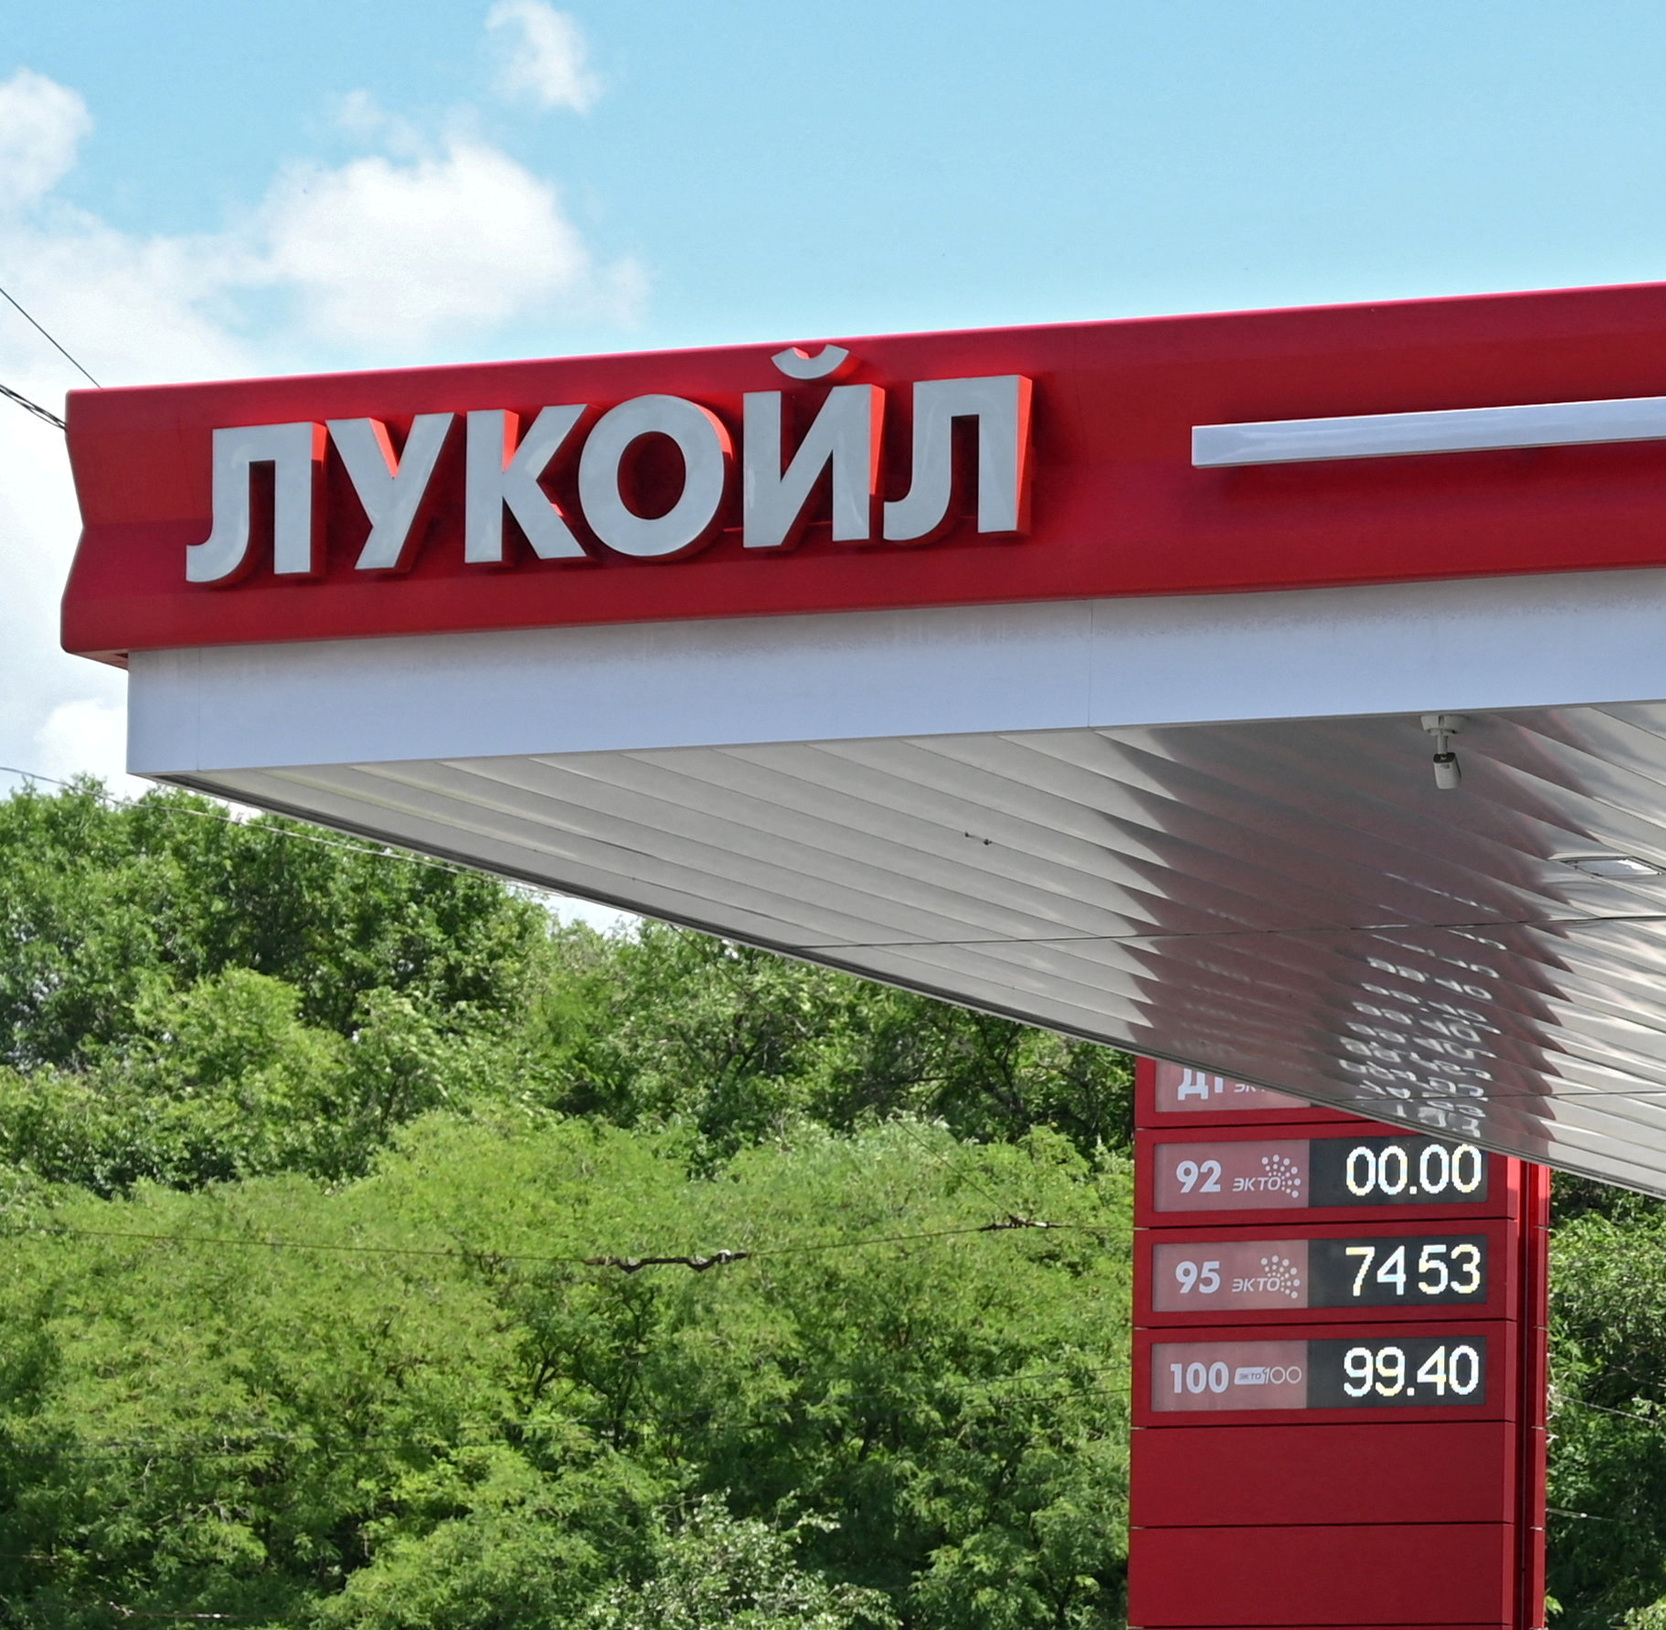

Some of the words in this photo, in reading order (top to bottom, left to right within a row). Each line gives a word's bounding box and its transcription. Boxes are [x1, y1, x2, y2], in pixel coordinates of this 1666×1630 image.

[184, 343, 1034, 584] ЛУКОЙЛ
[1176, 1160, 1222, 1194] 92
[1231, 1176, 1281, 1193] ЭКТО
[1346, 1143, 1483, 1197] 00.00
[1175, 1260, 1222, 1295] 95
[1231, 1276, 1280, 1293] ЭКТО
[1170, 1360, 1230, 1395] 100
[1343, 1344, 1480, 1399] 99.40
